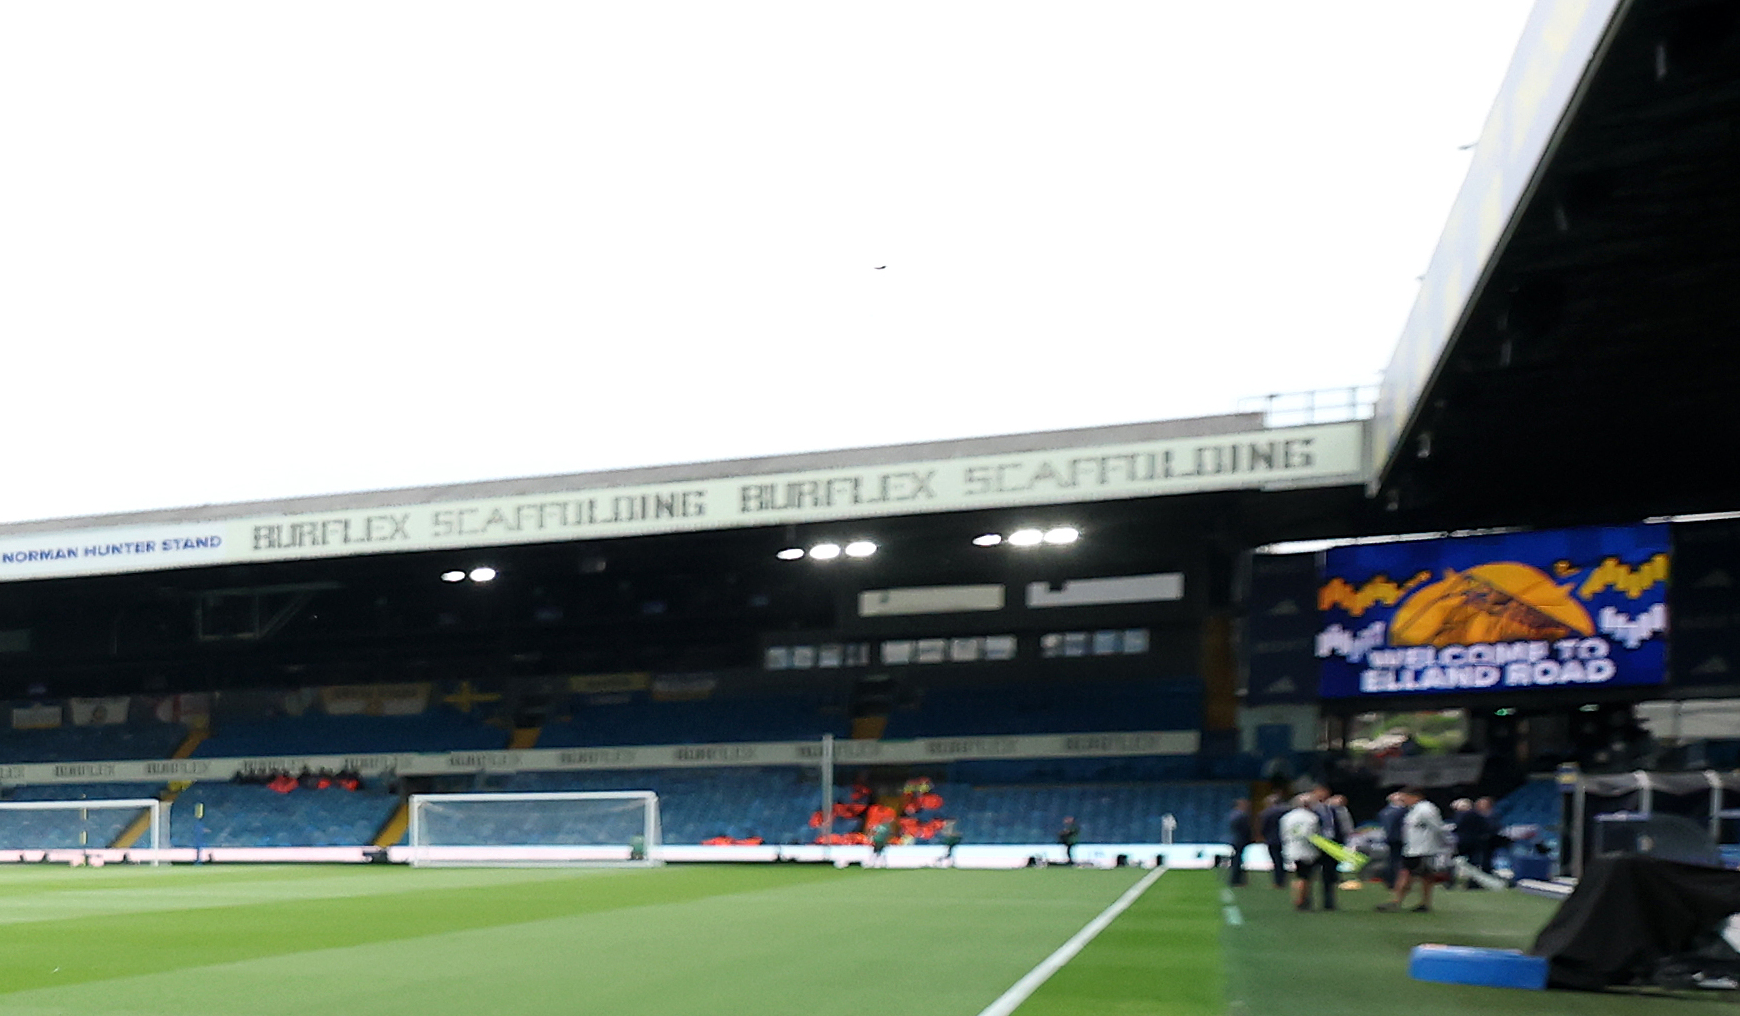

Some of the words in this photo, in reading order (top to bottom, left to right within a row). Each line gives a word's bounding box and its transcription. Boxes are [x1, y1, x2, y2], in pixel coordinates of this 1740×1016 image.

[739, 469, 937, 513] BURFLEX
[963, 437, 1315, 495] SCAFFOLDING
[253, 512, 410, 551] BURFLEX
[432, 490, 707, 538] SCAFFOLDING
[2, 547, 78, 563] NORMAN
[84, 540, 155, 557] HUNTER
[162, 535, 222, 551] STAND
[1368, 640, 1550, 669] WELCOME
[1553, 636, 1610, 660] TO
[1359, 665, 1501, 693] ELLAND
[1503, 658, 1617, 686] ROAD
